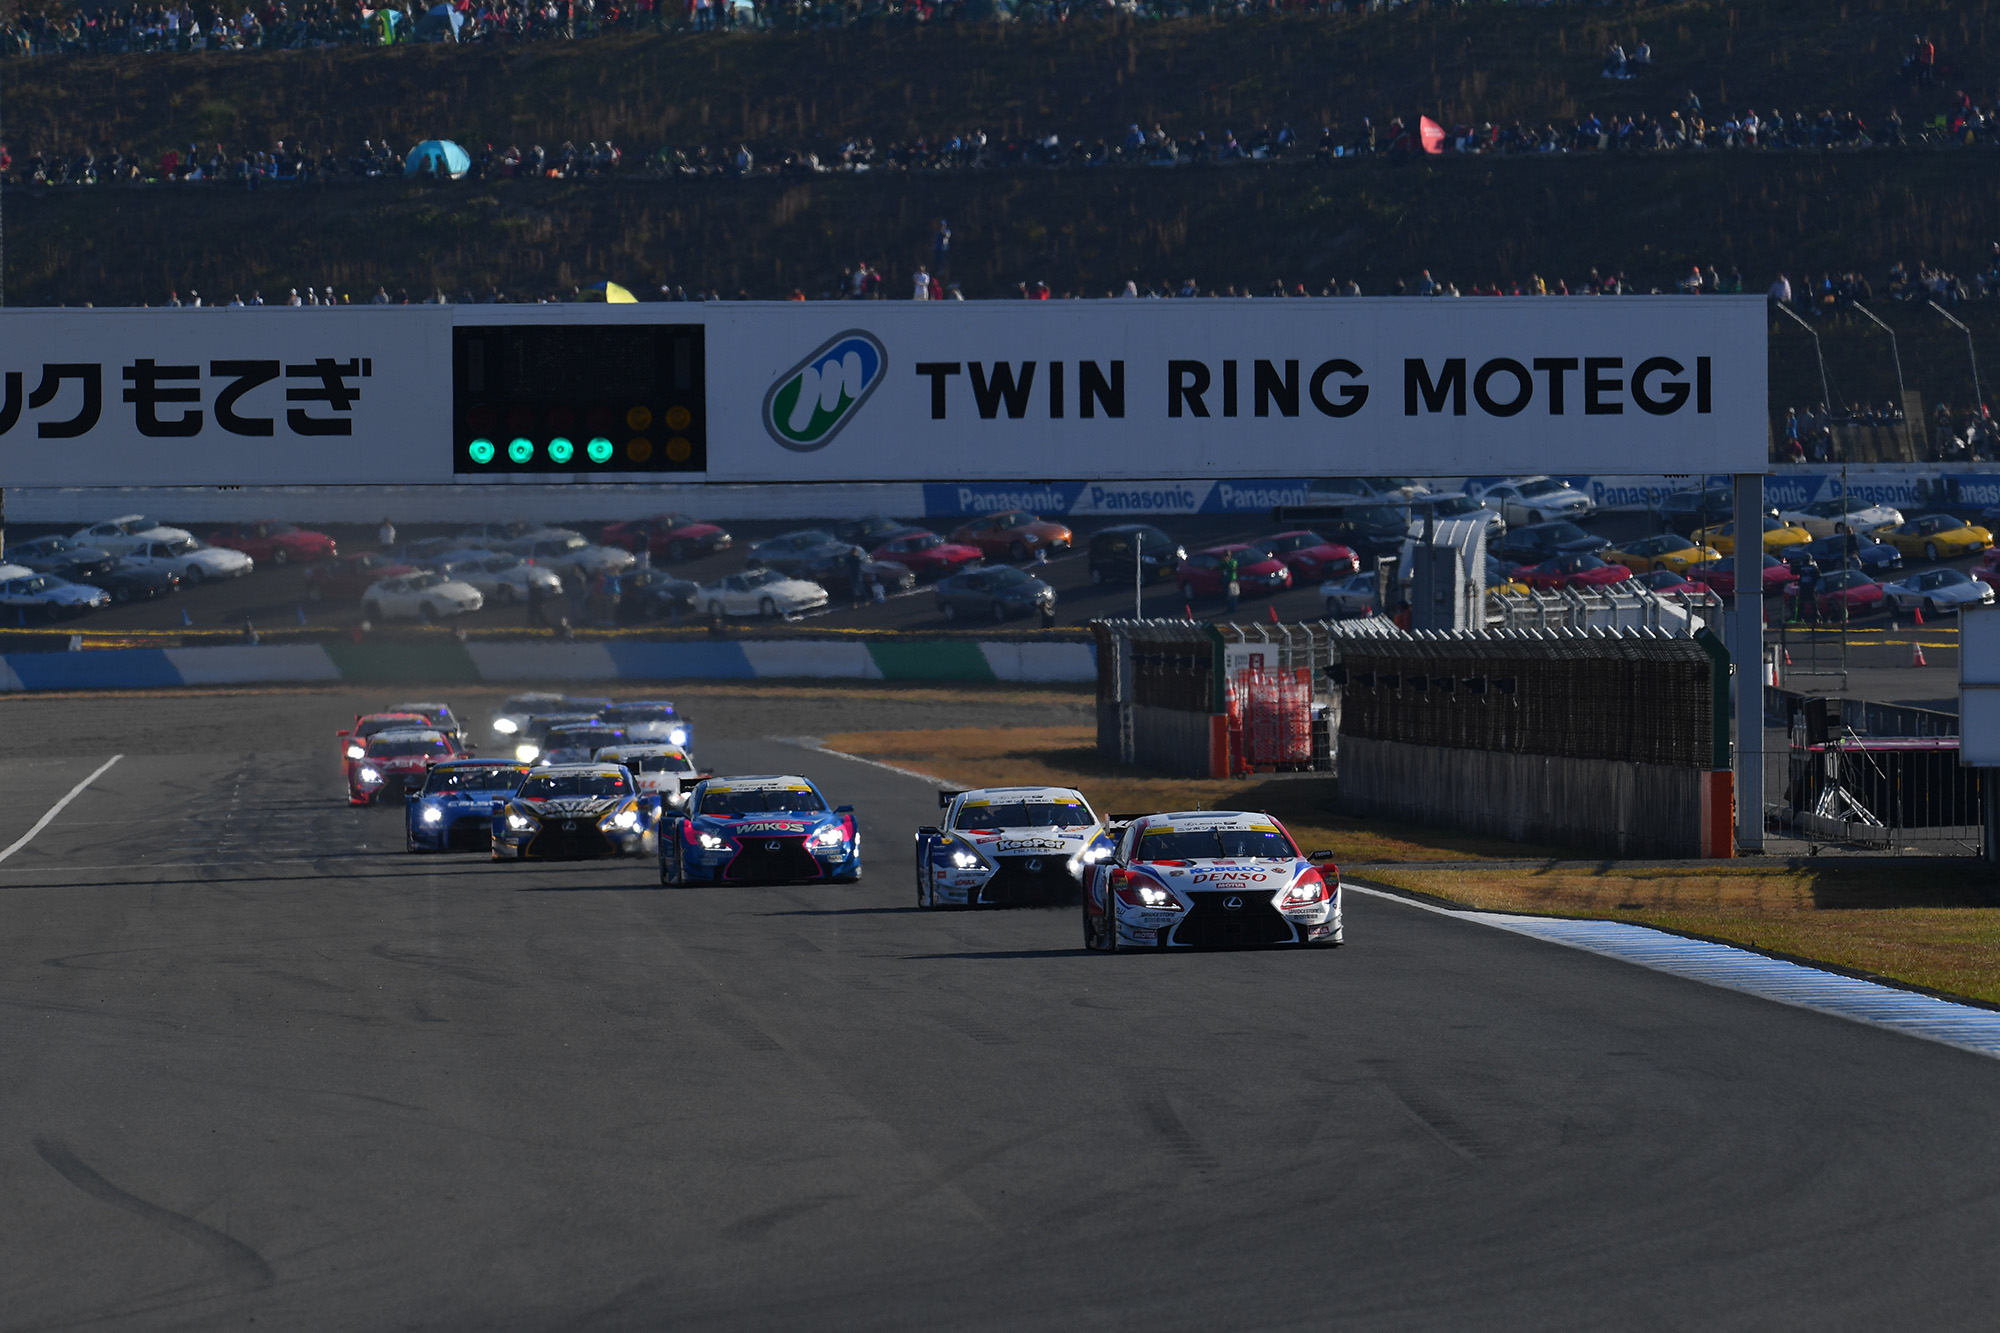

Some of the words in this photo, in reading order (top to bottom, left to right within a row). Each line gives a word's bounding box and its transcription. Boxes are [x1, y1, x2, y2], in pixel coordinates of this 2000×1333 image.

[915, 360, 1125, 419] TWIN
[1168, 358, 1369, 418] RING
[1404, 355, 1712, 417] MOTEGI
[957, 485, 1065, 512] Panasonic
[1091, 485, 1195, 510] Panasonic
[1219, 483, 1309, 508] Panasoni
[736, 822, 805, 835] WAKO'S
[998, 838, 1064, 851] KeePer
[1189, 866, 1265, 875] KOBELCO
[1192, 872, 1267, 884] DENSO
